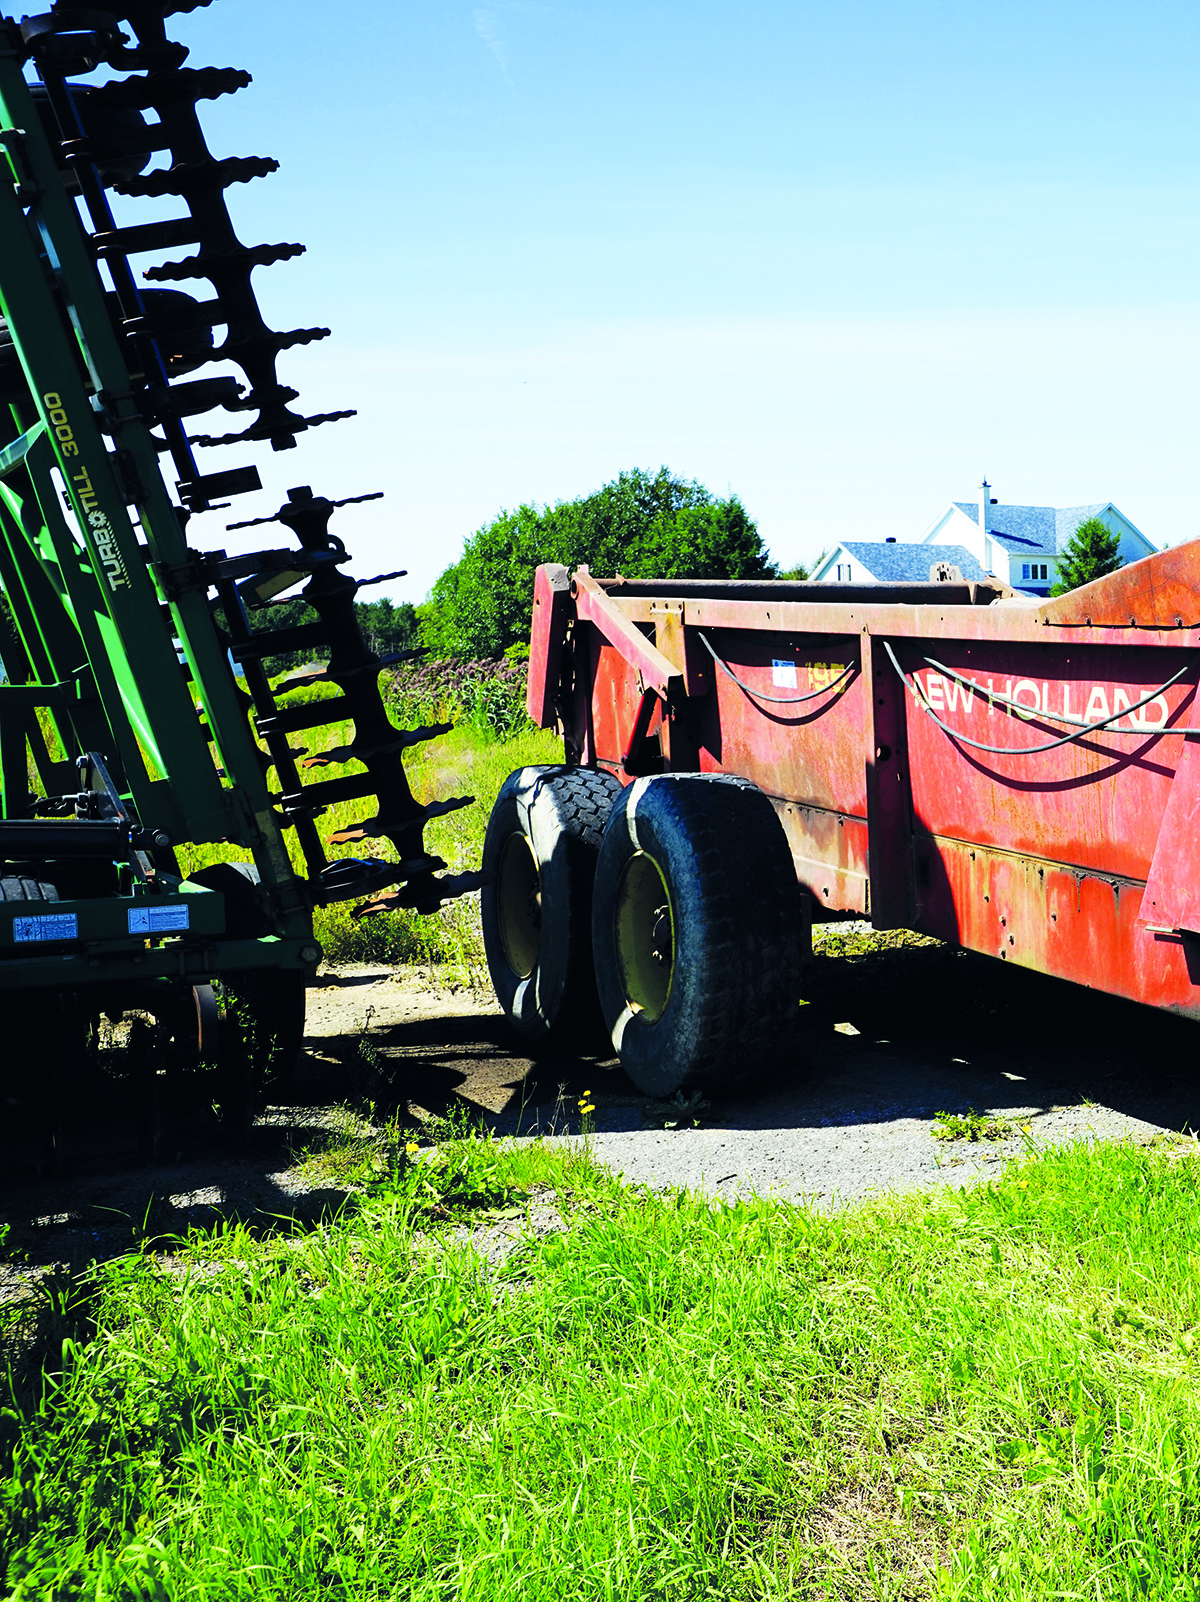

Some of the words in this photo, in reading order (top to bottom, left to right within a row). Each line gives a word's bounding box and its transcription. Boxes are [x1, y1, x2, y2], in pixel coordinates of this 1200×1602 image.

[44, 392, 79, 457] 3000
[912, 672, 976, 713] NEW
[988, 679, 1169, 730] HOLLAND
